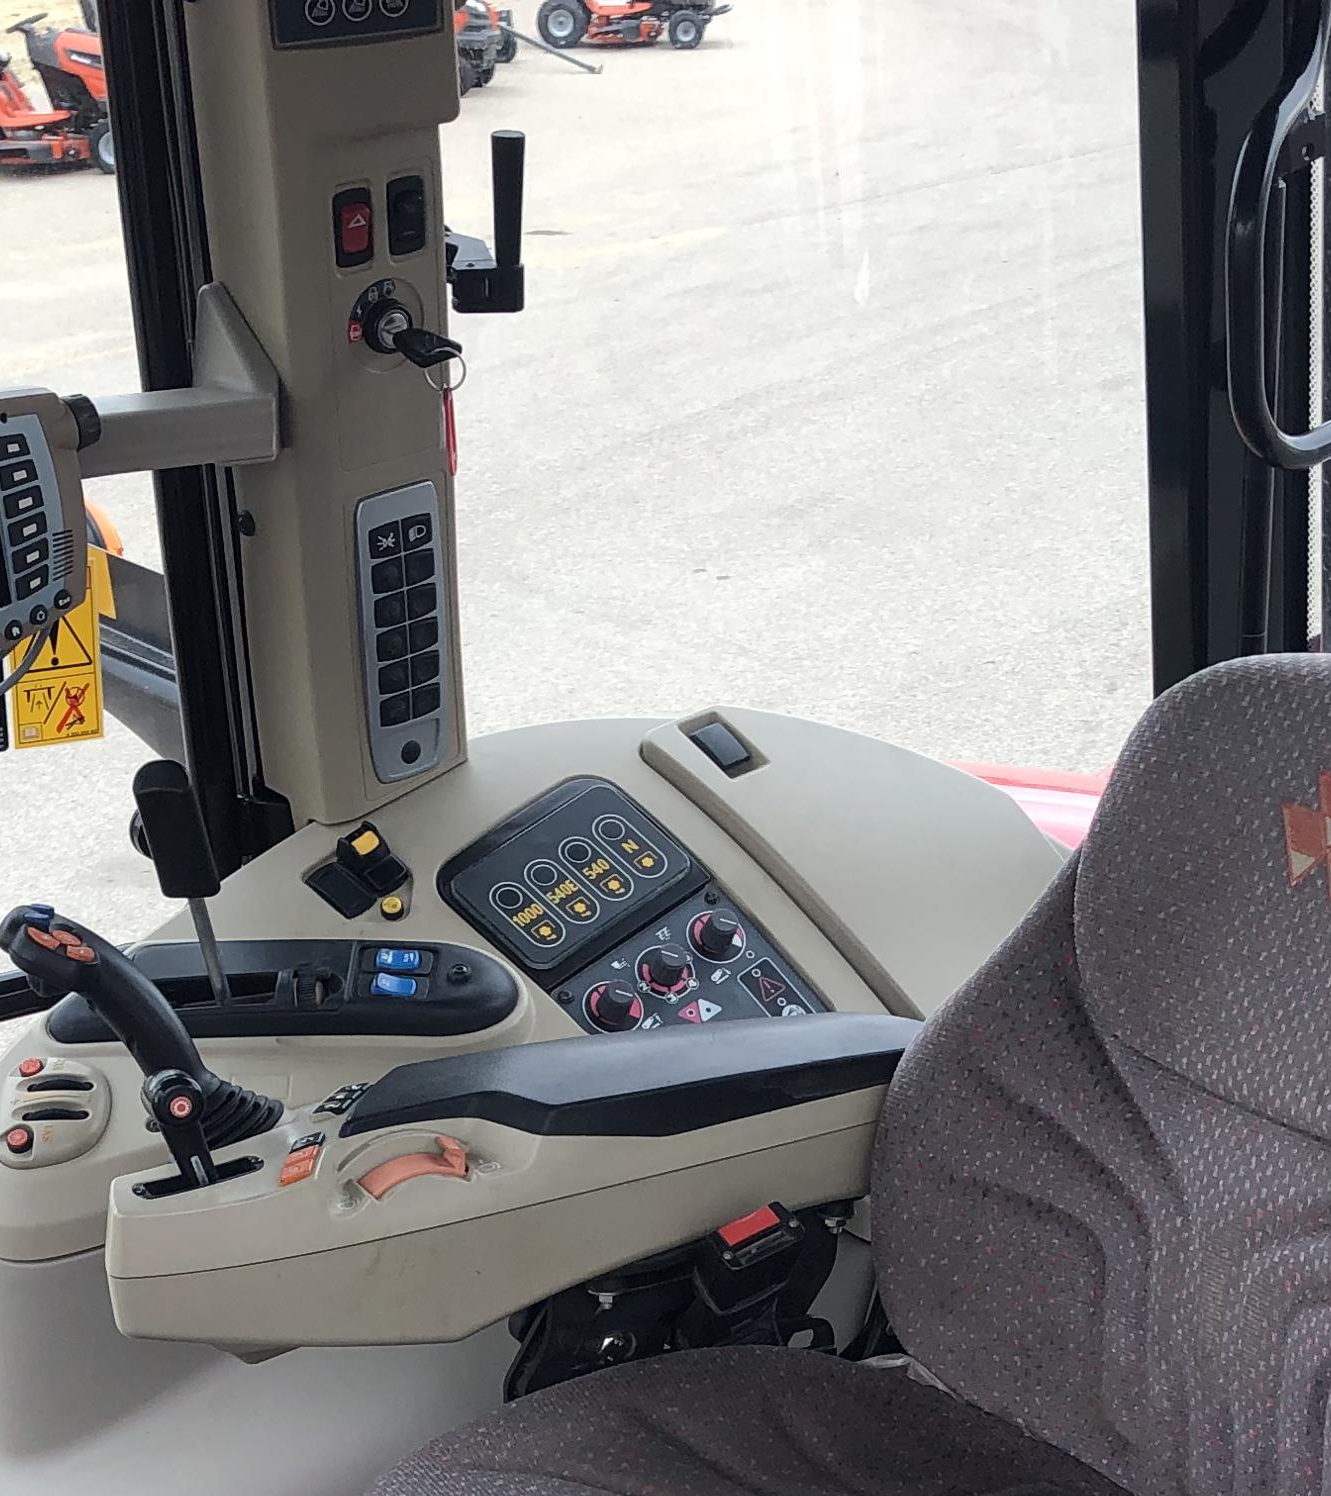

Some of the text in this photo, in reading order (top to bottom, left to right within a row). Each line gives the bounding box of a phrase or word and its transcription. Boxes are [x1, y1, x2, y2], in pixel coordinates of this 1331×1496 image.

[582, 858, 611, 880] 540
[546, 879, 580, 905] 540E
[512, 903, 545, 927] 1000
